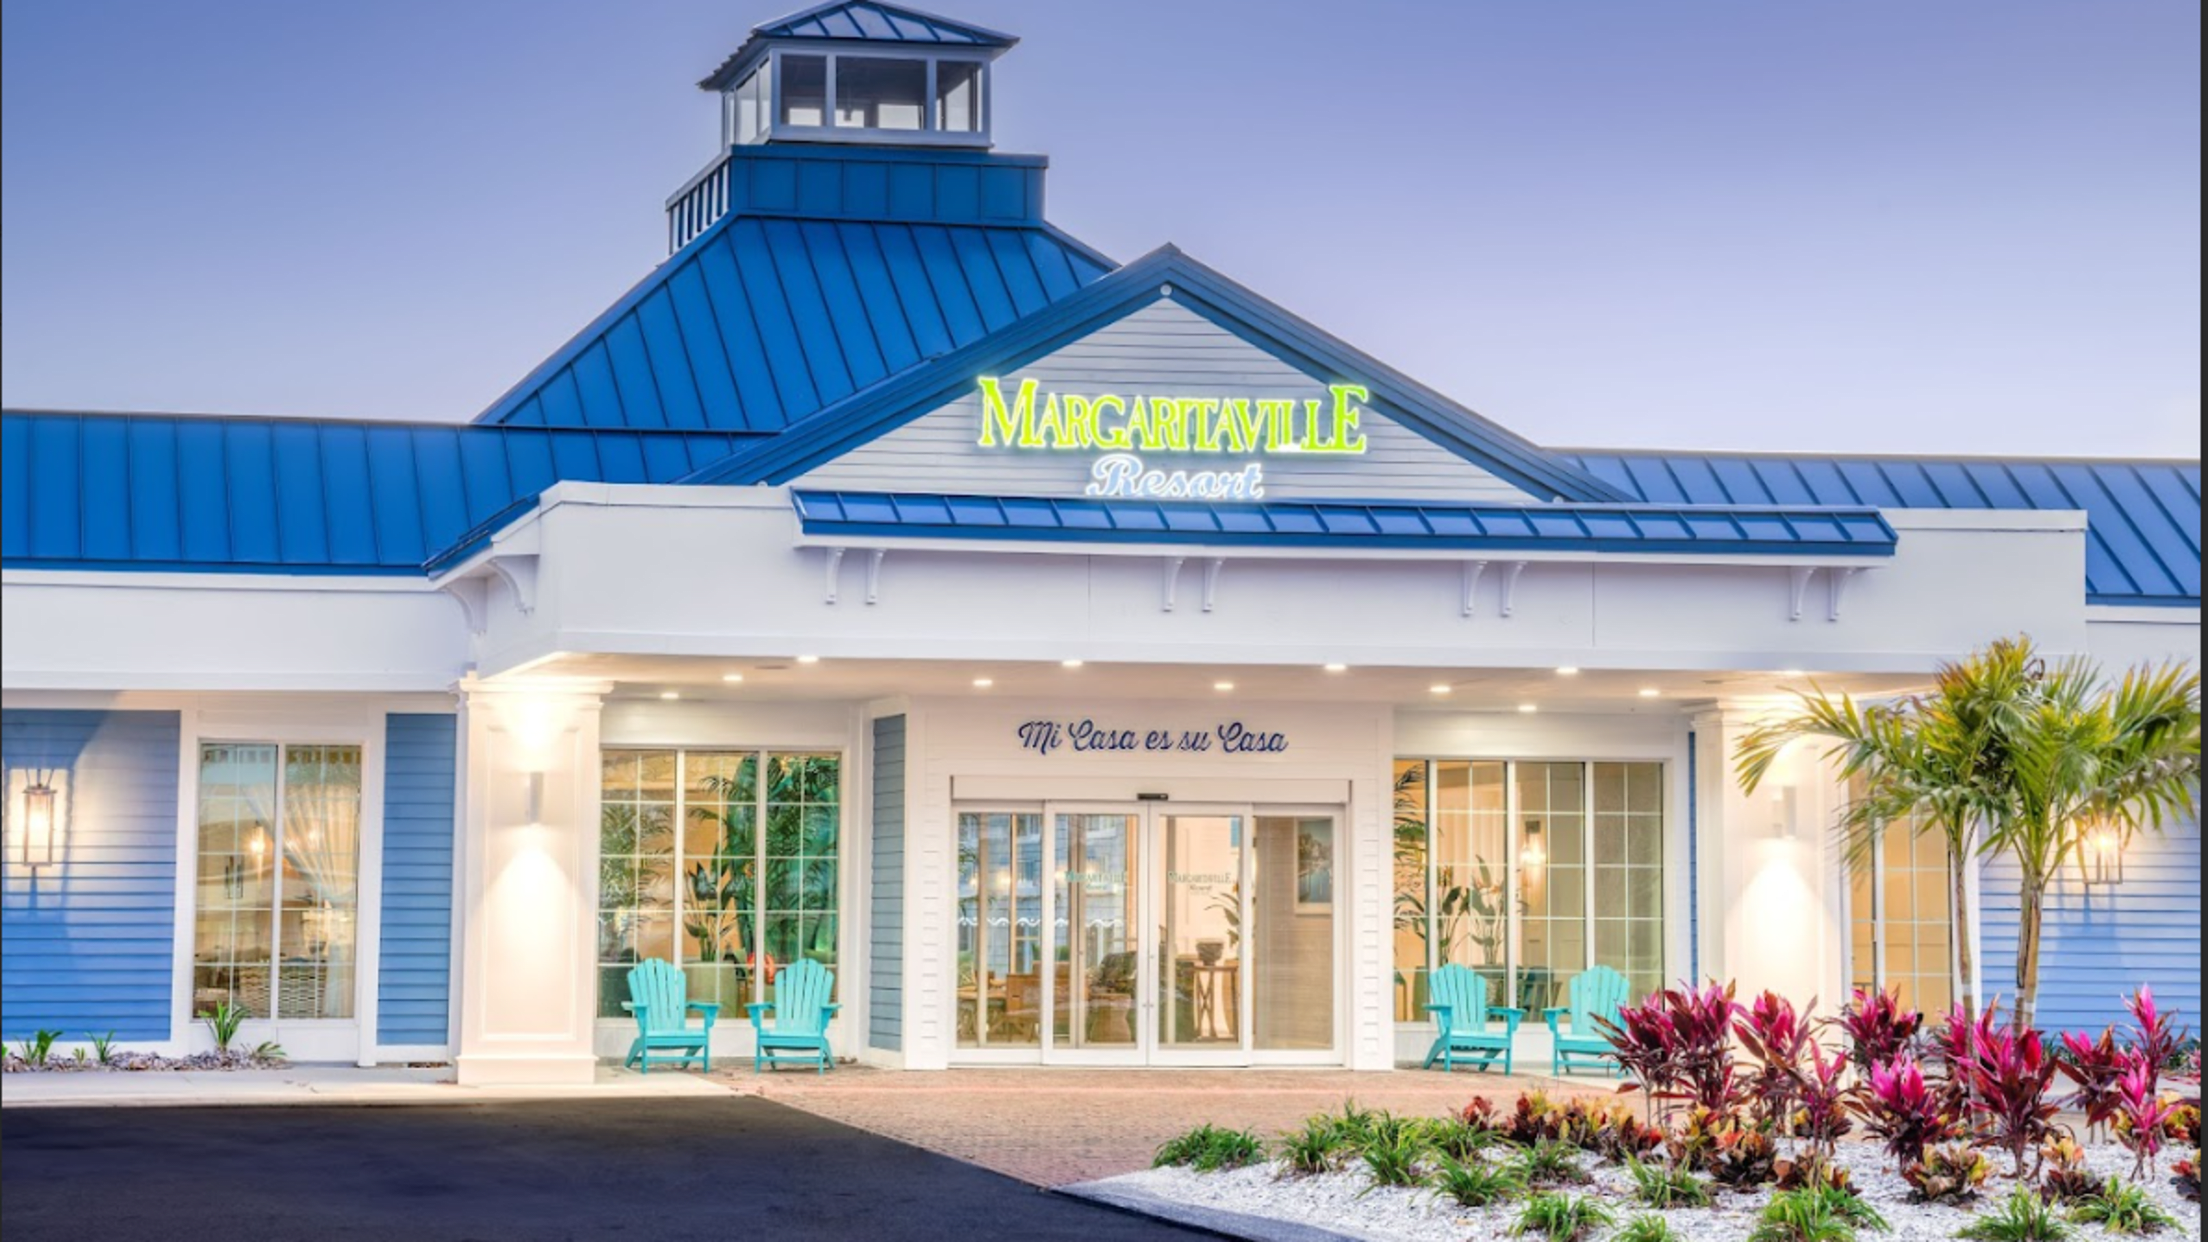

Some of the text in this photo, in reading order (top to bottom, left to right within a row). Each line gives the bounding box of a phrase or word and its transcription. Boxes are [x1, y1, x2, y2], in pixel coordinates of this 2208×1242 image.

[977, 376, 1368, 453] MARGARITAVILLE
[1086, 453, 1264, 498] Resort
[1018, 719, 1289, 755] Mi Casa es su Casa
